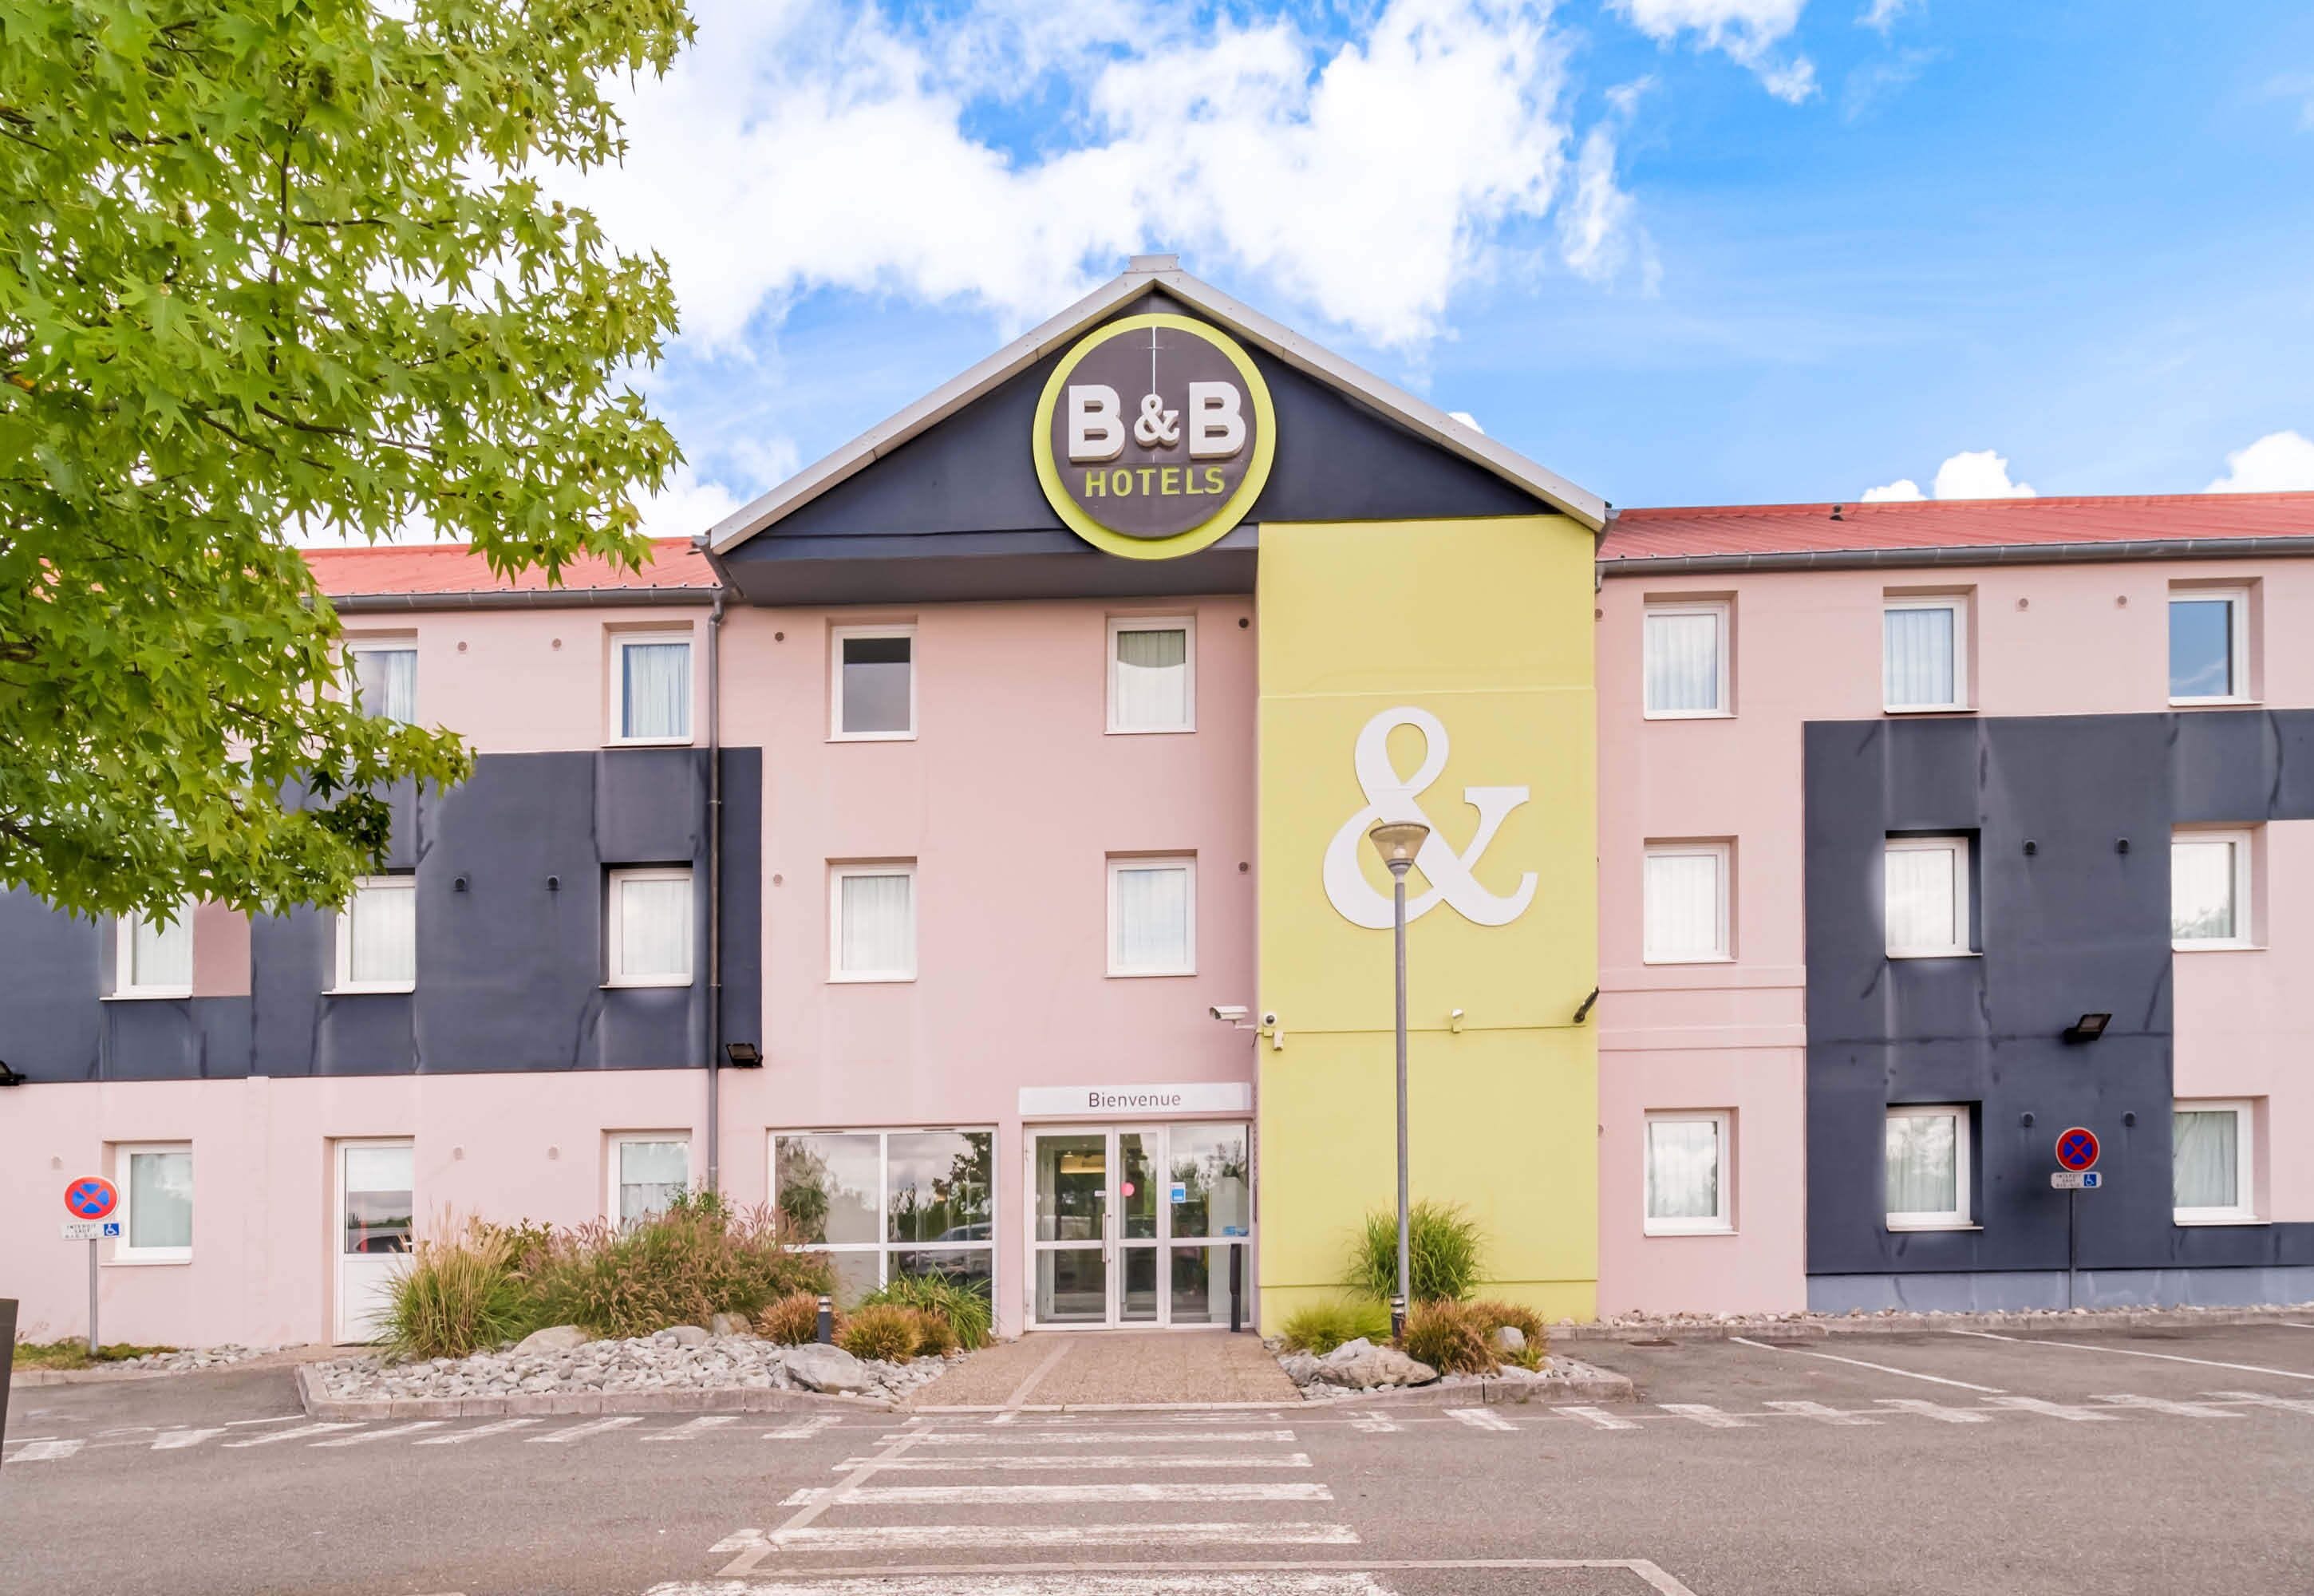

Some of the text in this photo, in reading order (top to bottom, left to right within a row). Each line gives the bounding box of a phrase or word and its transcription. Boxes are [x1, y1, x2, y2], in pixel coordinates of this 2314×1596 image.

[1068, 381, 1246, 463] B&B
[1085, 467, 1226, 497] HOTELS
[1322, 705, 1538, 930] &
[1088, 1092, 1182, 1108] Bienvenue
